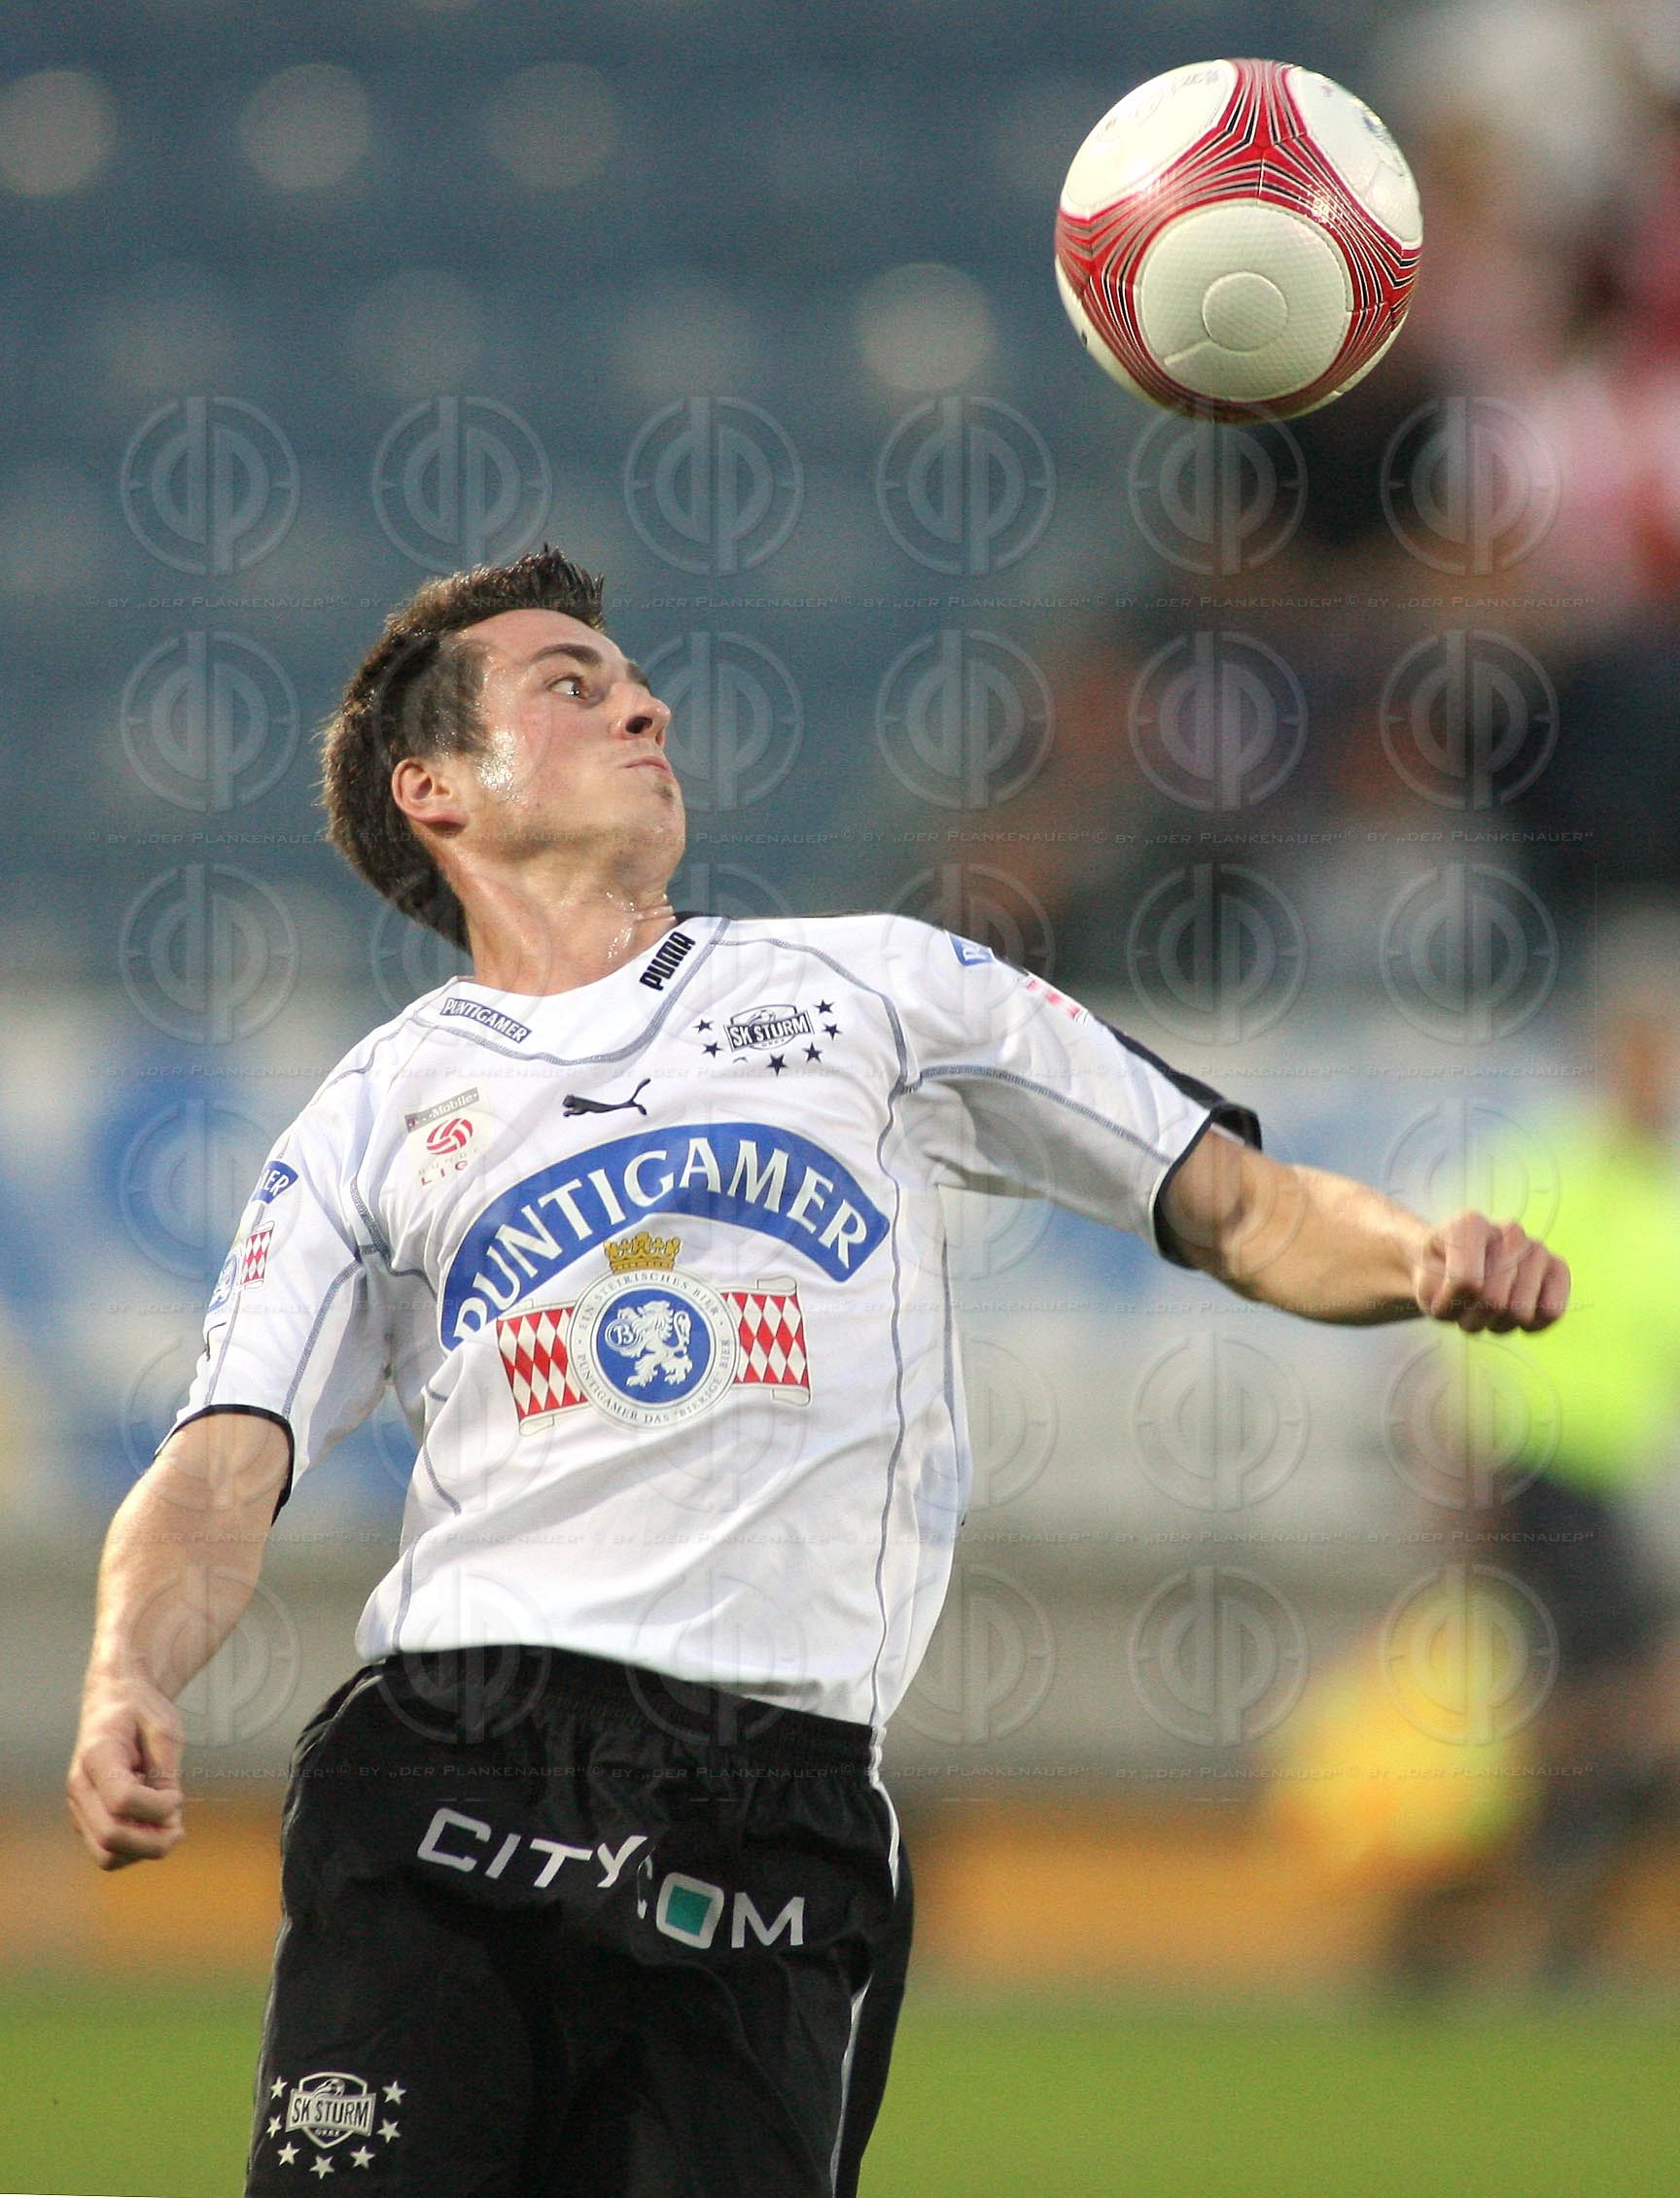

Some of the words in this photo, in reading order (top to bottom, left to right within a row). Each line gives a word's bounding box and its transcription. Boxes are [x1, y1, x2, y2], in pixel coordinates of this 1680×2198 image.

[639, 930, 696, 992] PUMA
[444, 997, 529, 1042] PUNTIGAMER
[730, 1025, 753, 1047] SK
[755, 1014, 809, 1041] STURM
[453, 1136, 868, 1343] PUNTIGAMER
[578, 1304, 595, 1331] EIN
[594, 1272, 689, 1302] STEIRISCHES
[693, 1288, 719, 1316] BIER
[577, 1353, 639, 1423] PUNTIGAMER
[644, 1413, 670, 1424] DAS
[718, 1340, 731, 1370] BIER
[417, 1807, 806, 1950] CITYOM
[292, 2098, 311, 2124] SK
[315, 2099, 369, 2129] STURM
